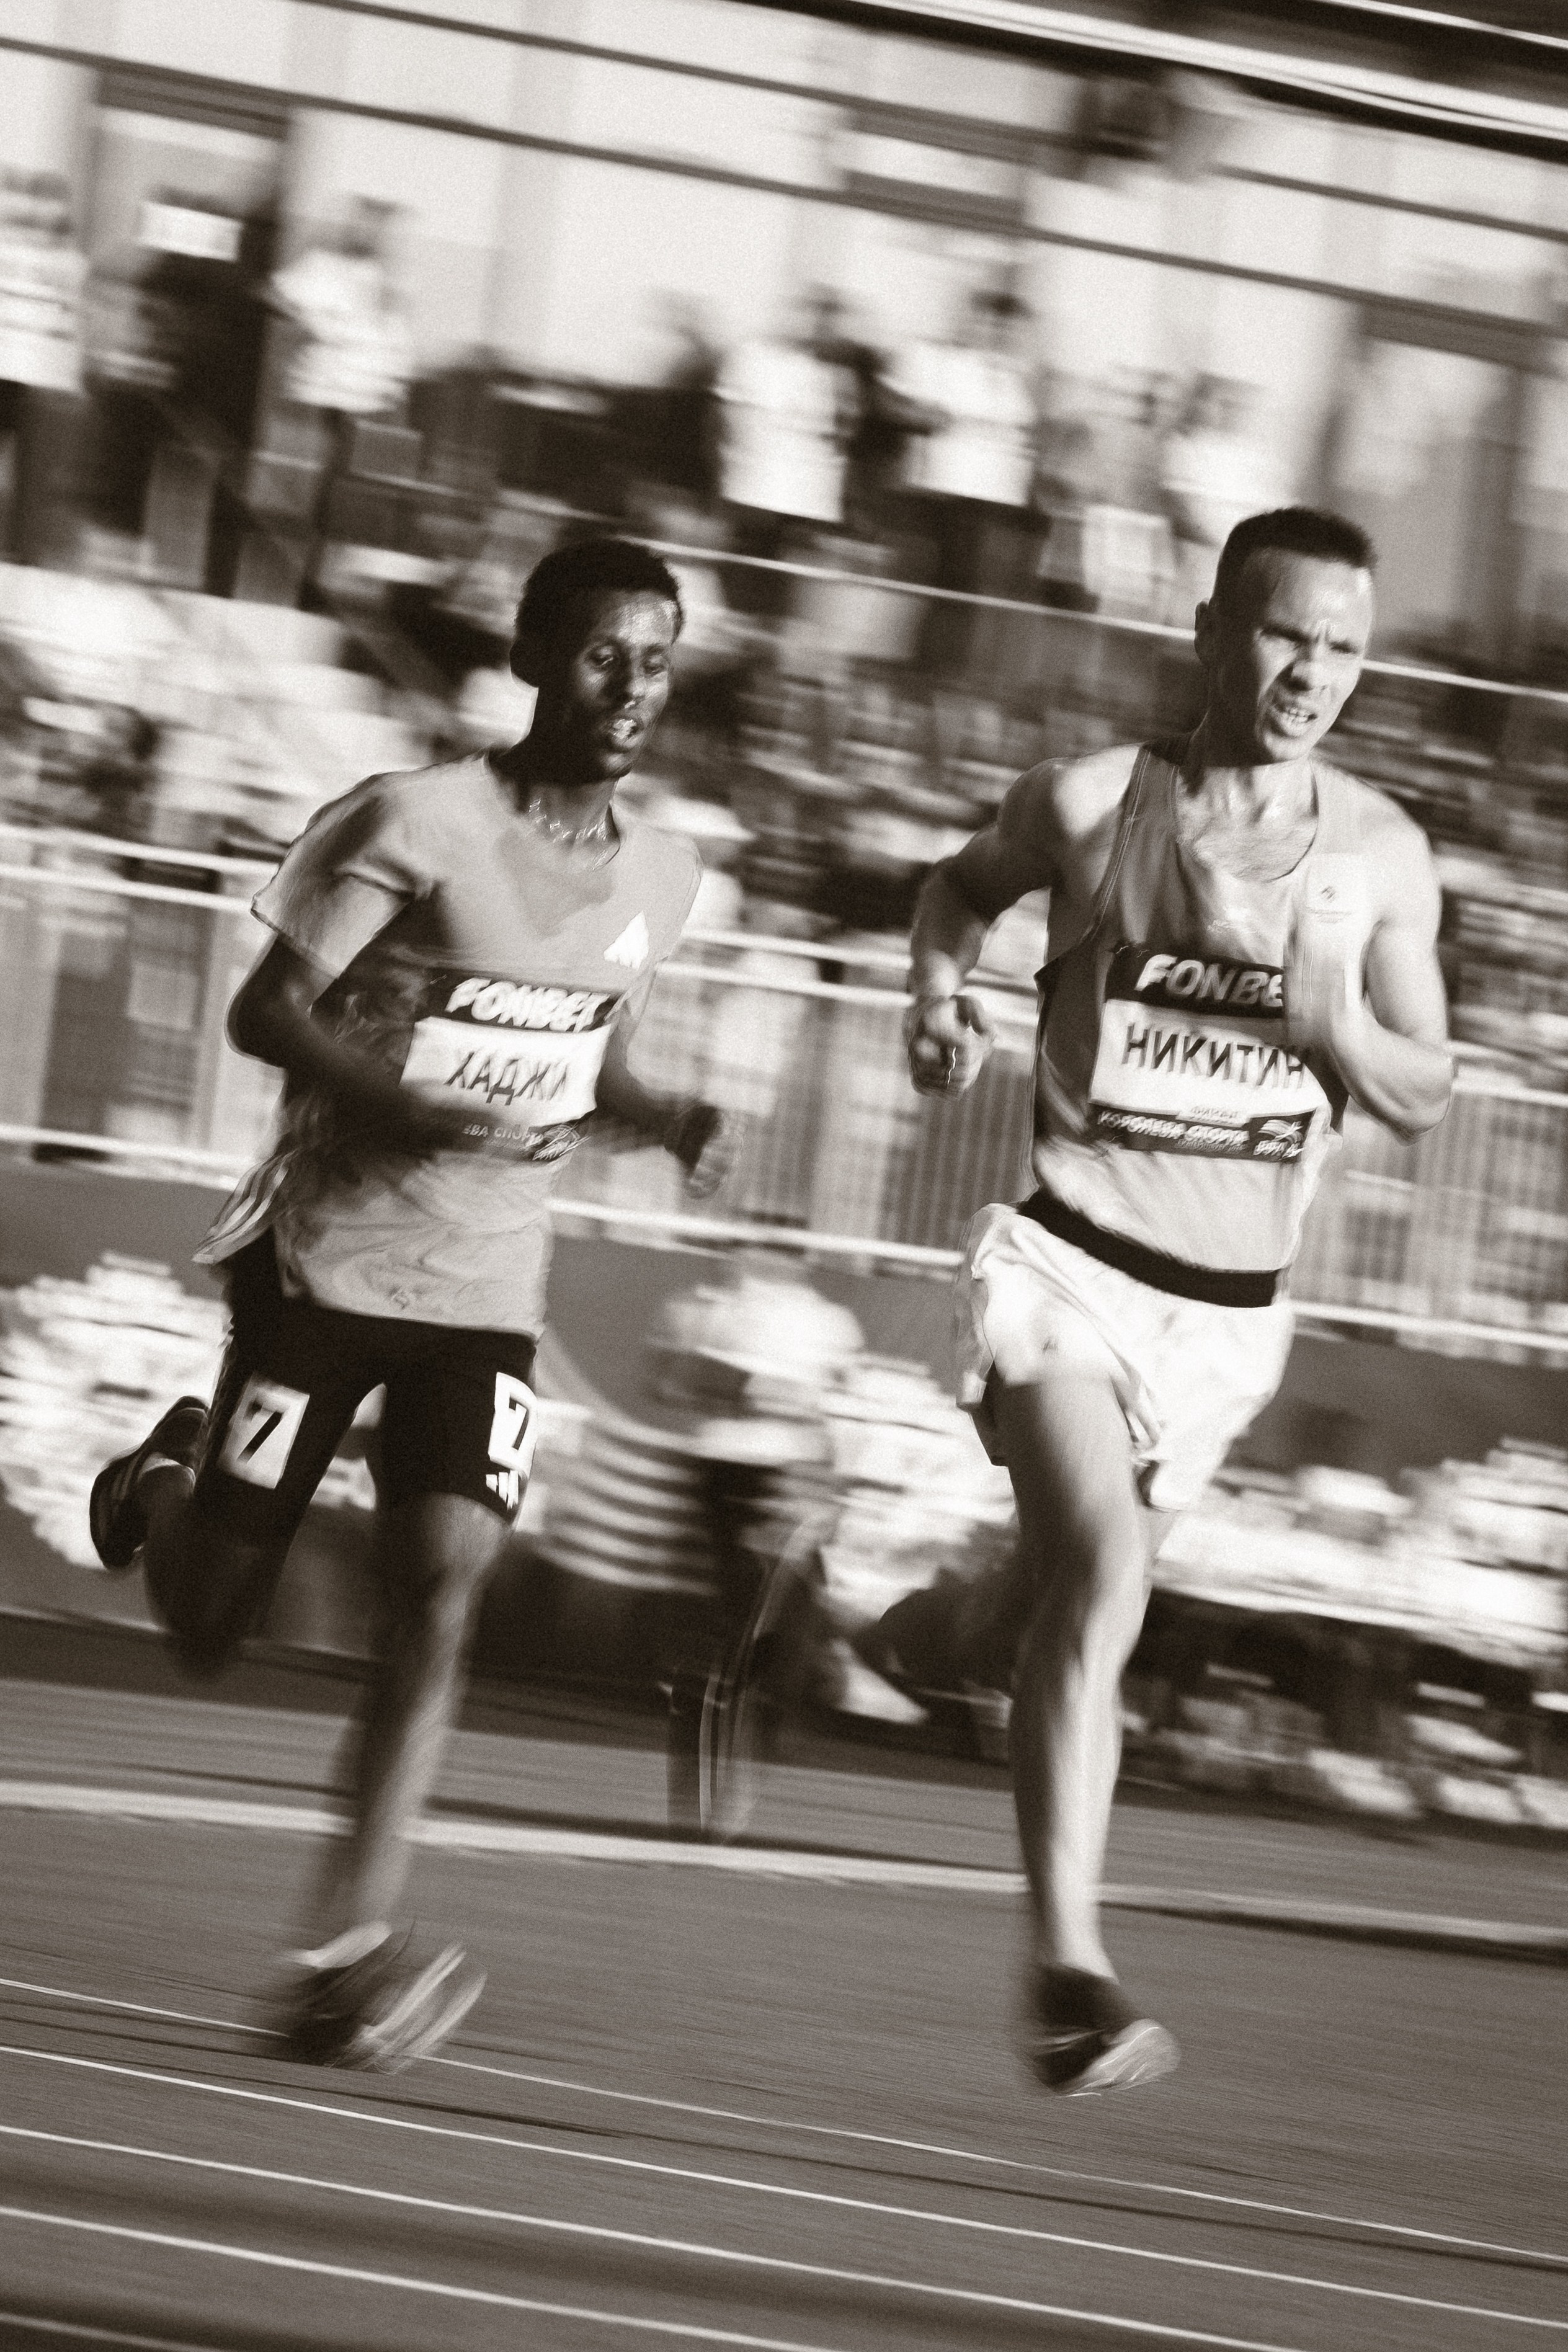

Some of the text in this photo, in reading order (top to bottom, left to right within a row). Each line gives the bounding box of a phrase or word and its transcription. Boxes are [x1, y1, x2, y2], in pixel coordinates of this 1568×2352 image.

[445, 976, 611, 1032] FONBET
[1135, 953, 1285, 1007] FONBE
[443, 1050, 569, 1106] ХАДЖИ
[1121, 1022, 1304, 1090] НИКИТИН
[238, 1392, 285, 1464] 7
[509, 1392, 529, 1451] 7
